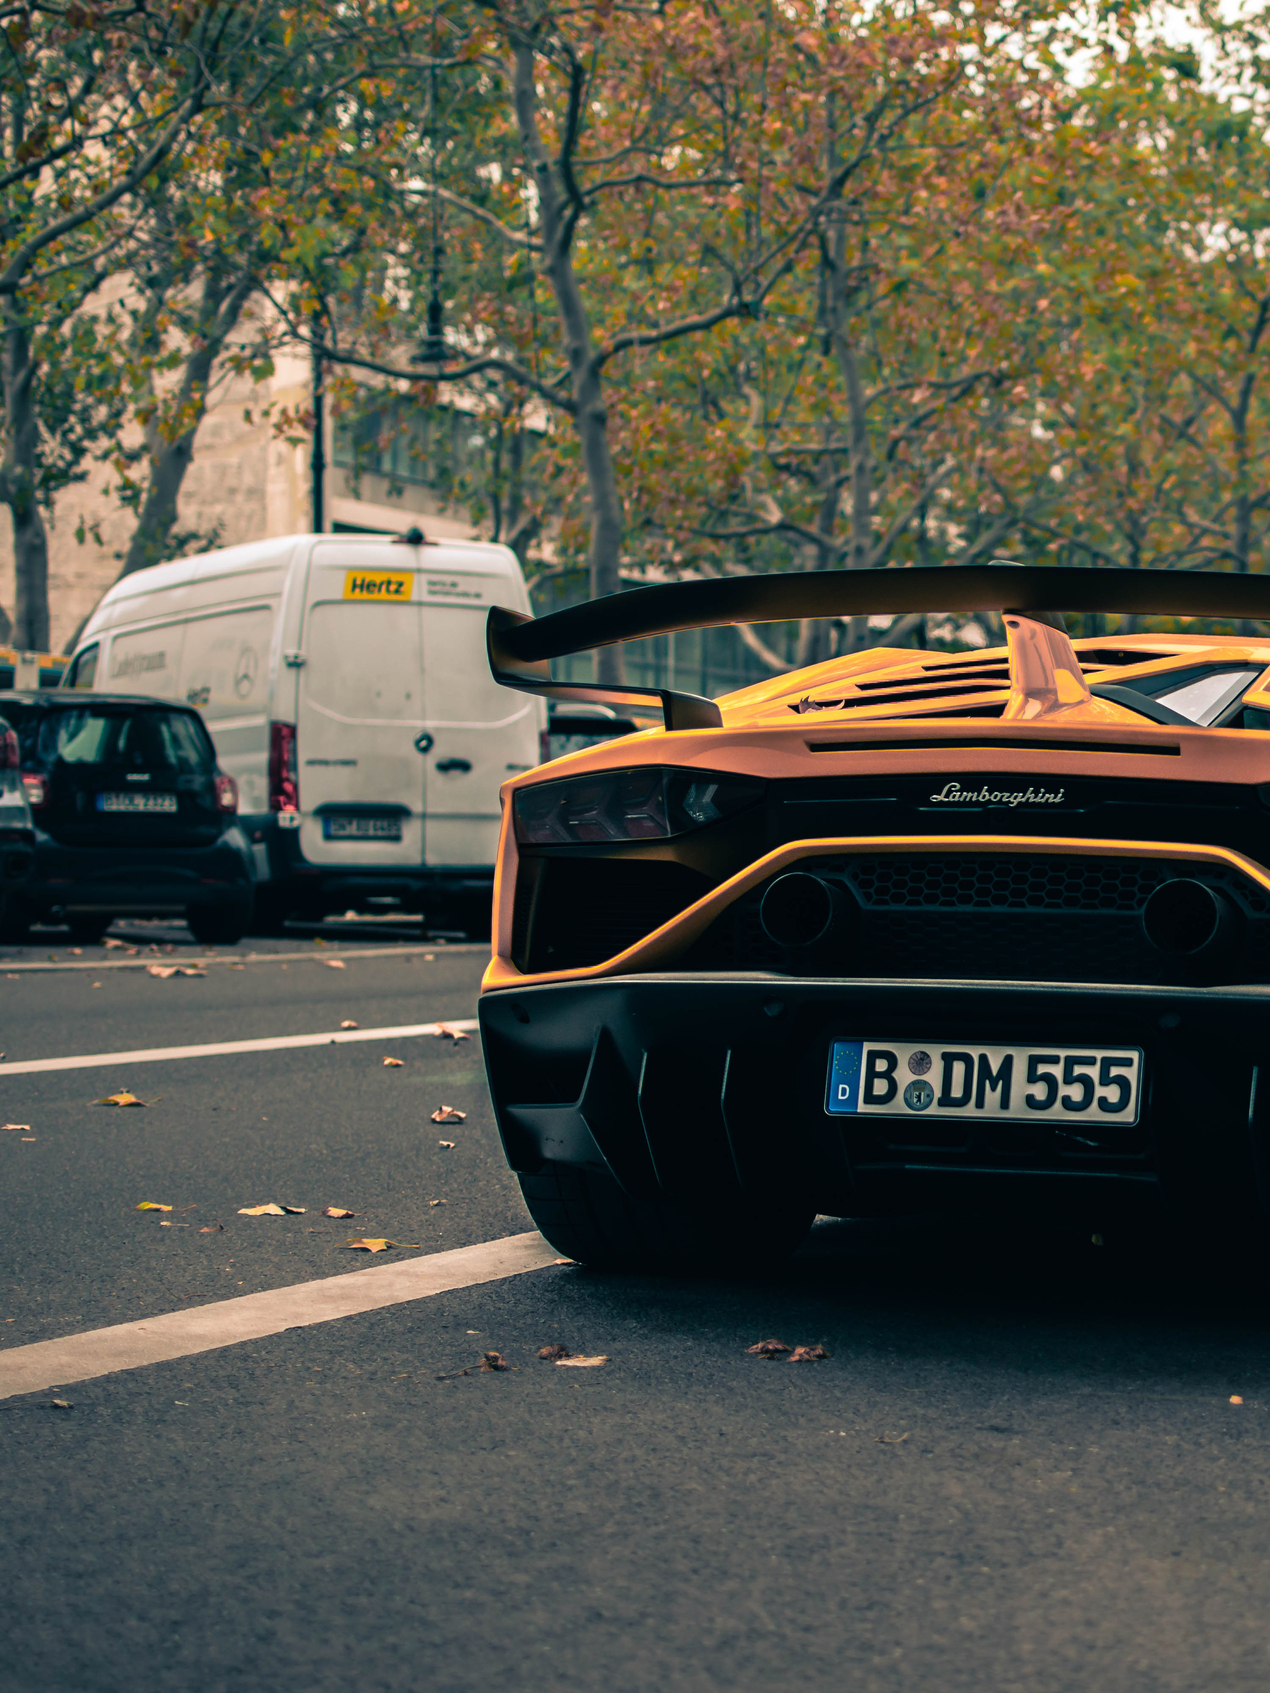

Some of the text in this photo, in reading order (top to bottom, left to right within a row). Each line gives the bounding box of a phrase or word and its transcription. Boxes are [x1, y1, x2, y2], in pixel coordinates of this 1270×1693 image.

[351, 577, 405, 595] Hertz
[929, 782, 1065, 807] Lamborghini
[837, 1049, 1134, 1113] D B DM 555
